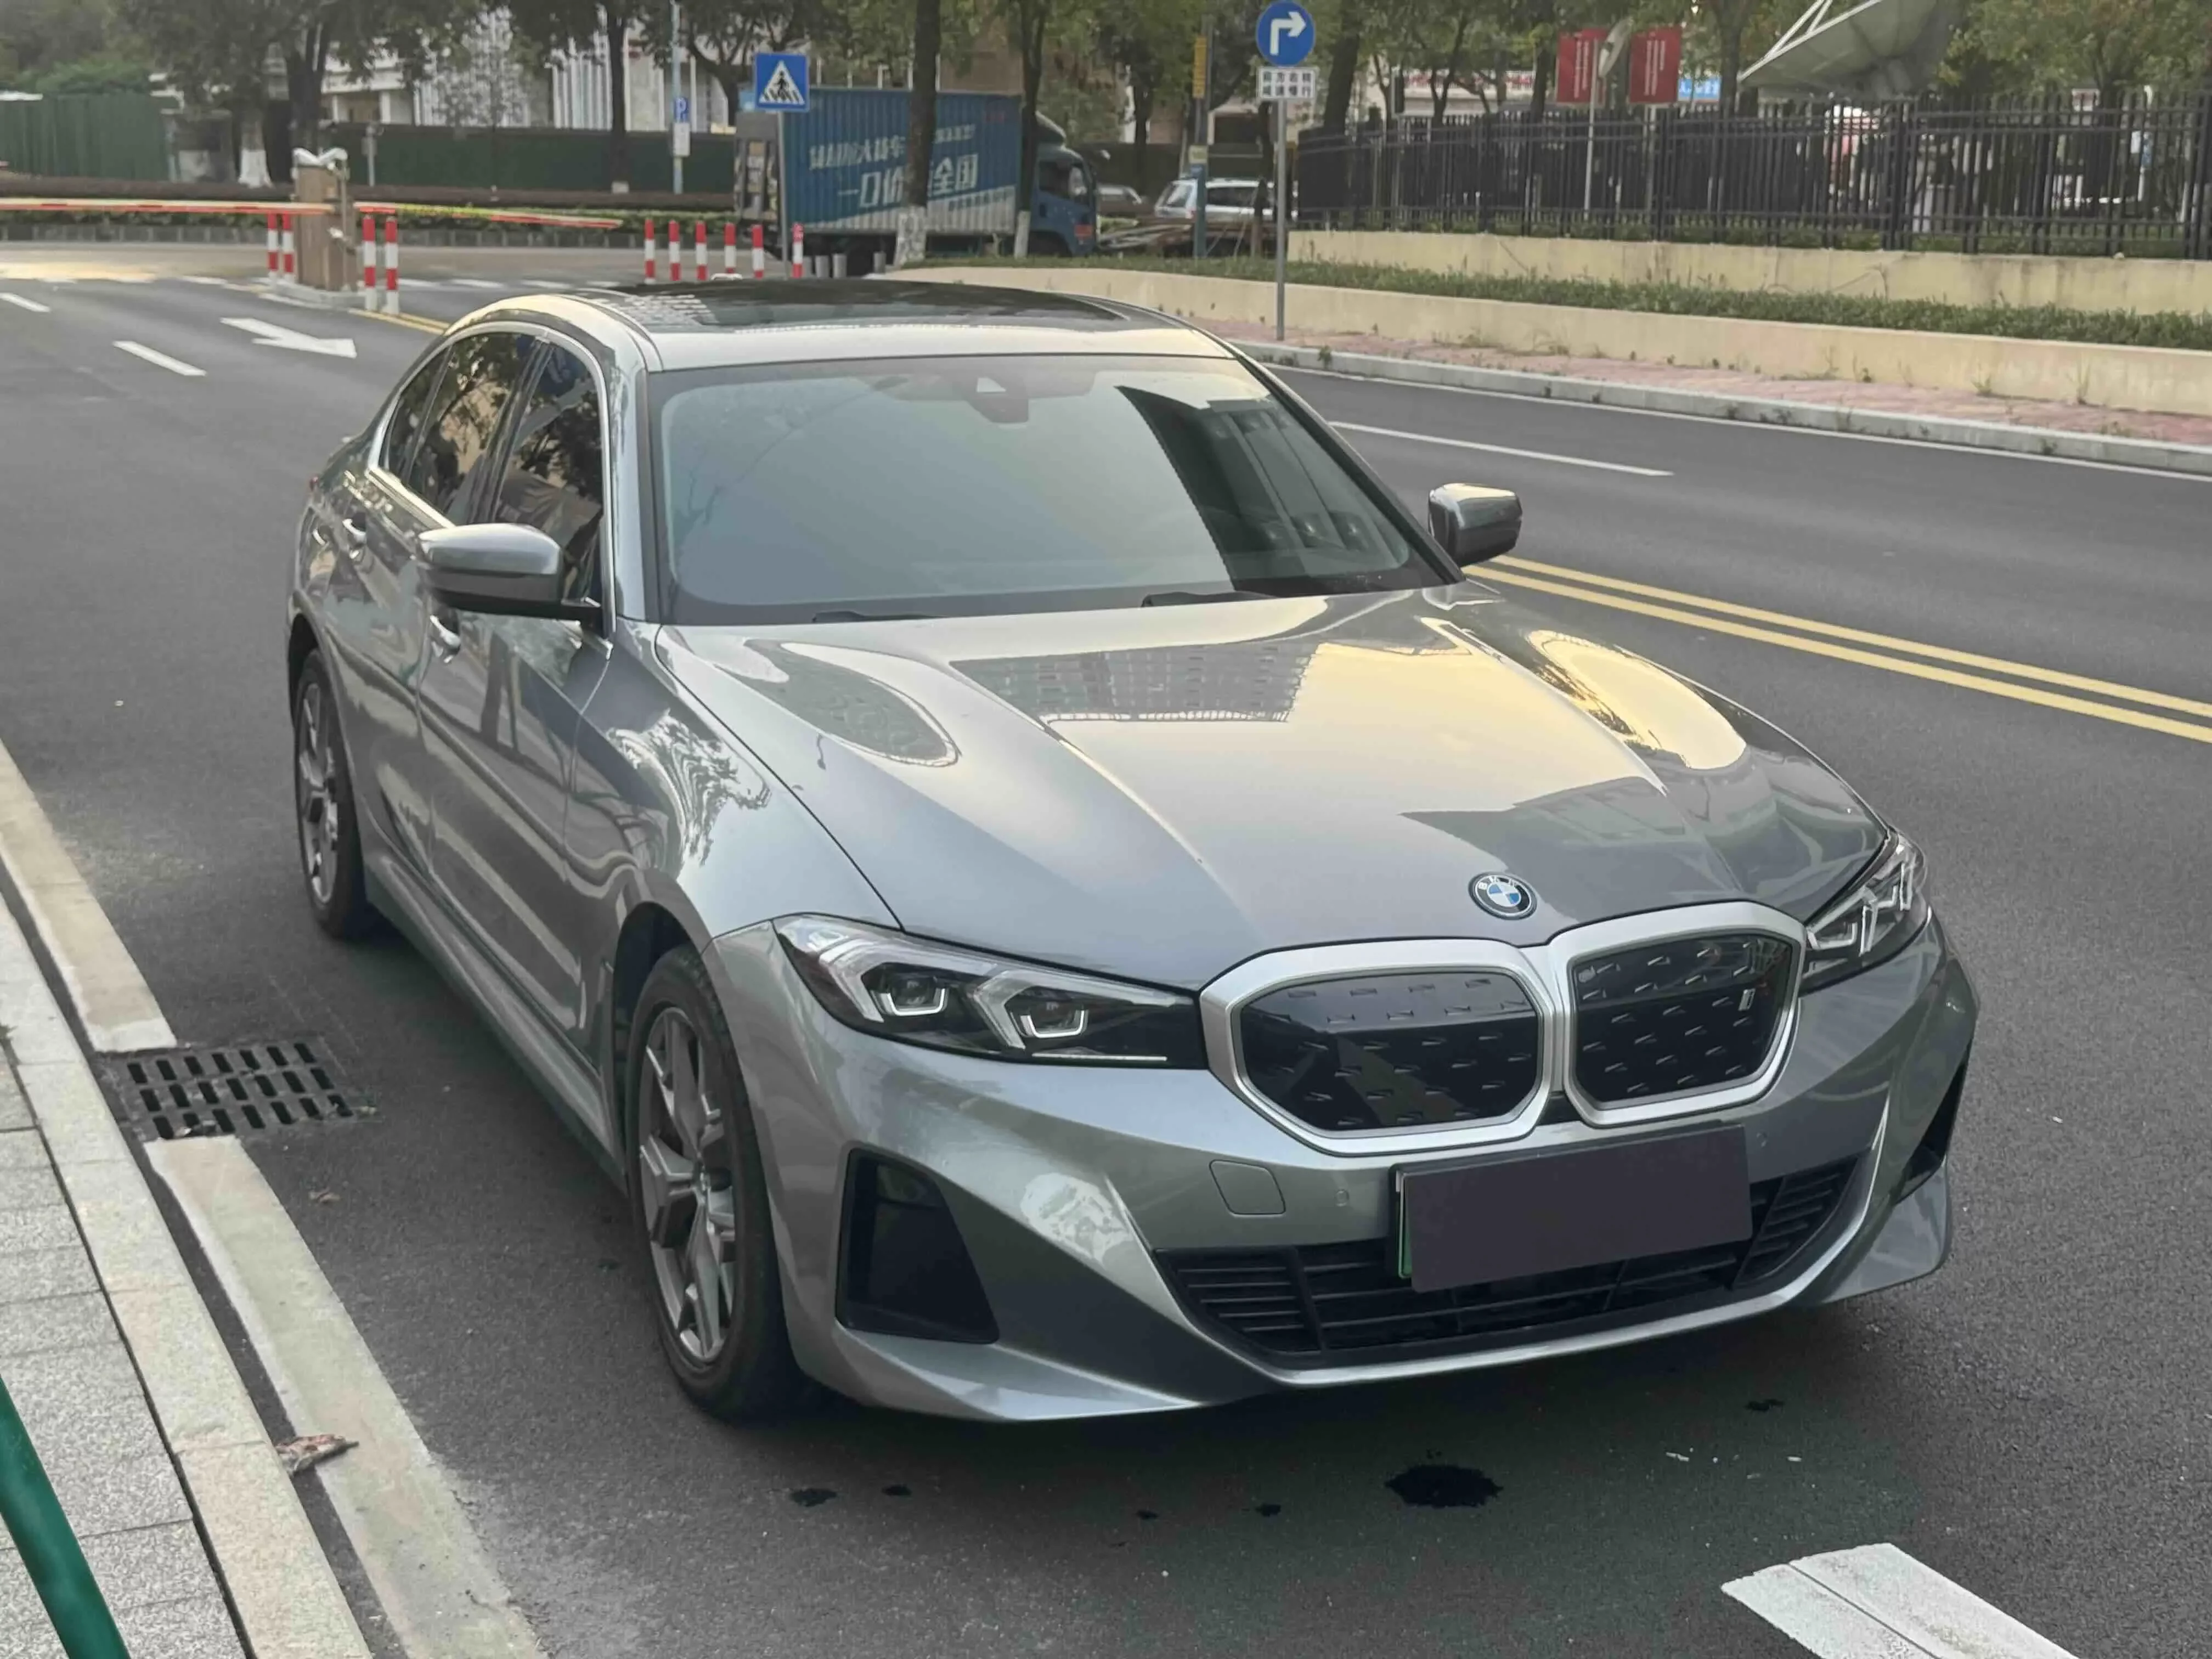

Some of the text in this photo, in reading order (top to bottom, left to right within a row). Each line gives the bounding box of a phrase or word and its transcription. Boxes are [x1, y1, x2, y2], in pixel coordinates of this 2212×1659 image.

[837, 153, 978, 208] 一口价全国
